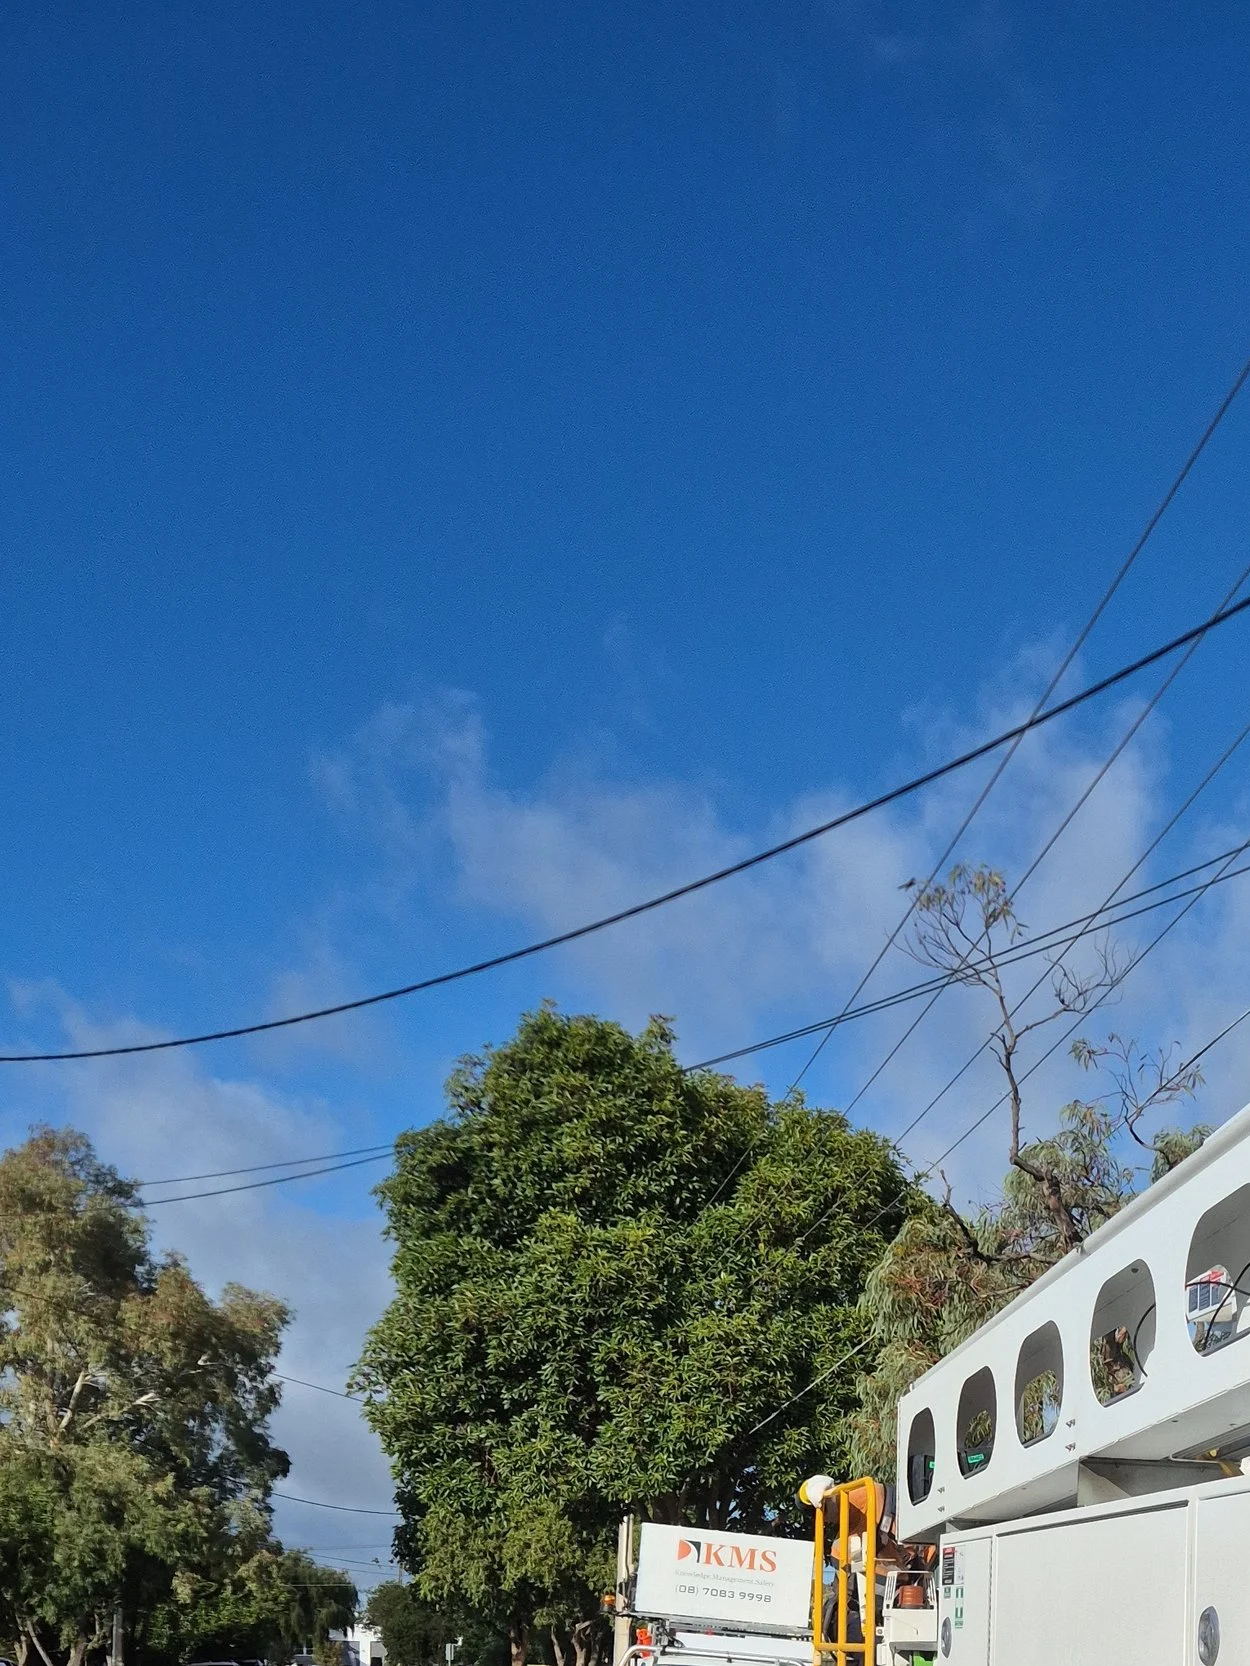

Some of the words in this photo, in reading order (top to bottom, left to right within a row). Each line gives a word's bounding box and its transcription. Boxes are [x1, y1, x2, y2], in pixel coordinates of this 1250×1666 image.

[703, 1542, 777, 1573] KMS
[675, 1584, 699, 1597] (08)
[702, 1587, 735, 1599] 7083
[738, 1591, 772, 1603] 9998
